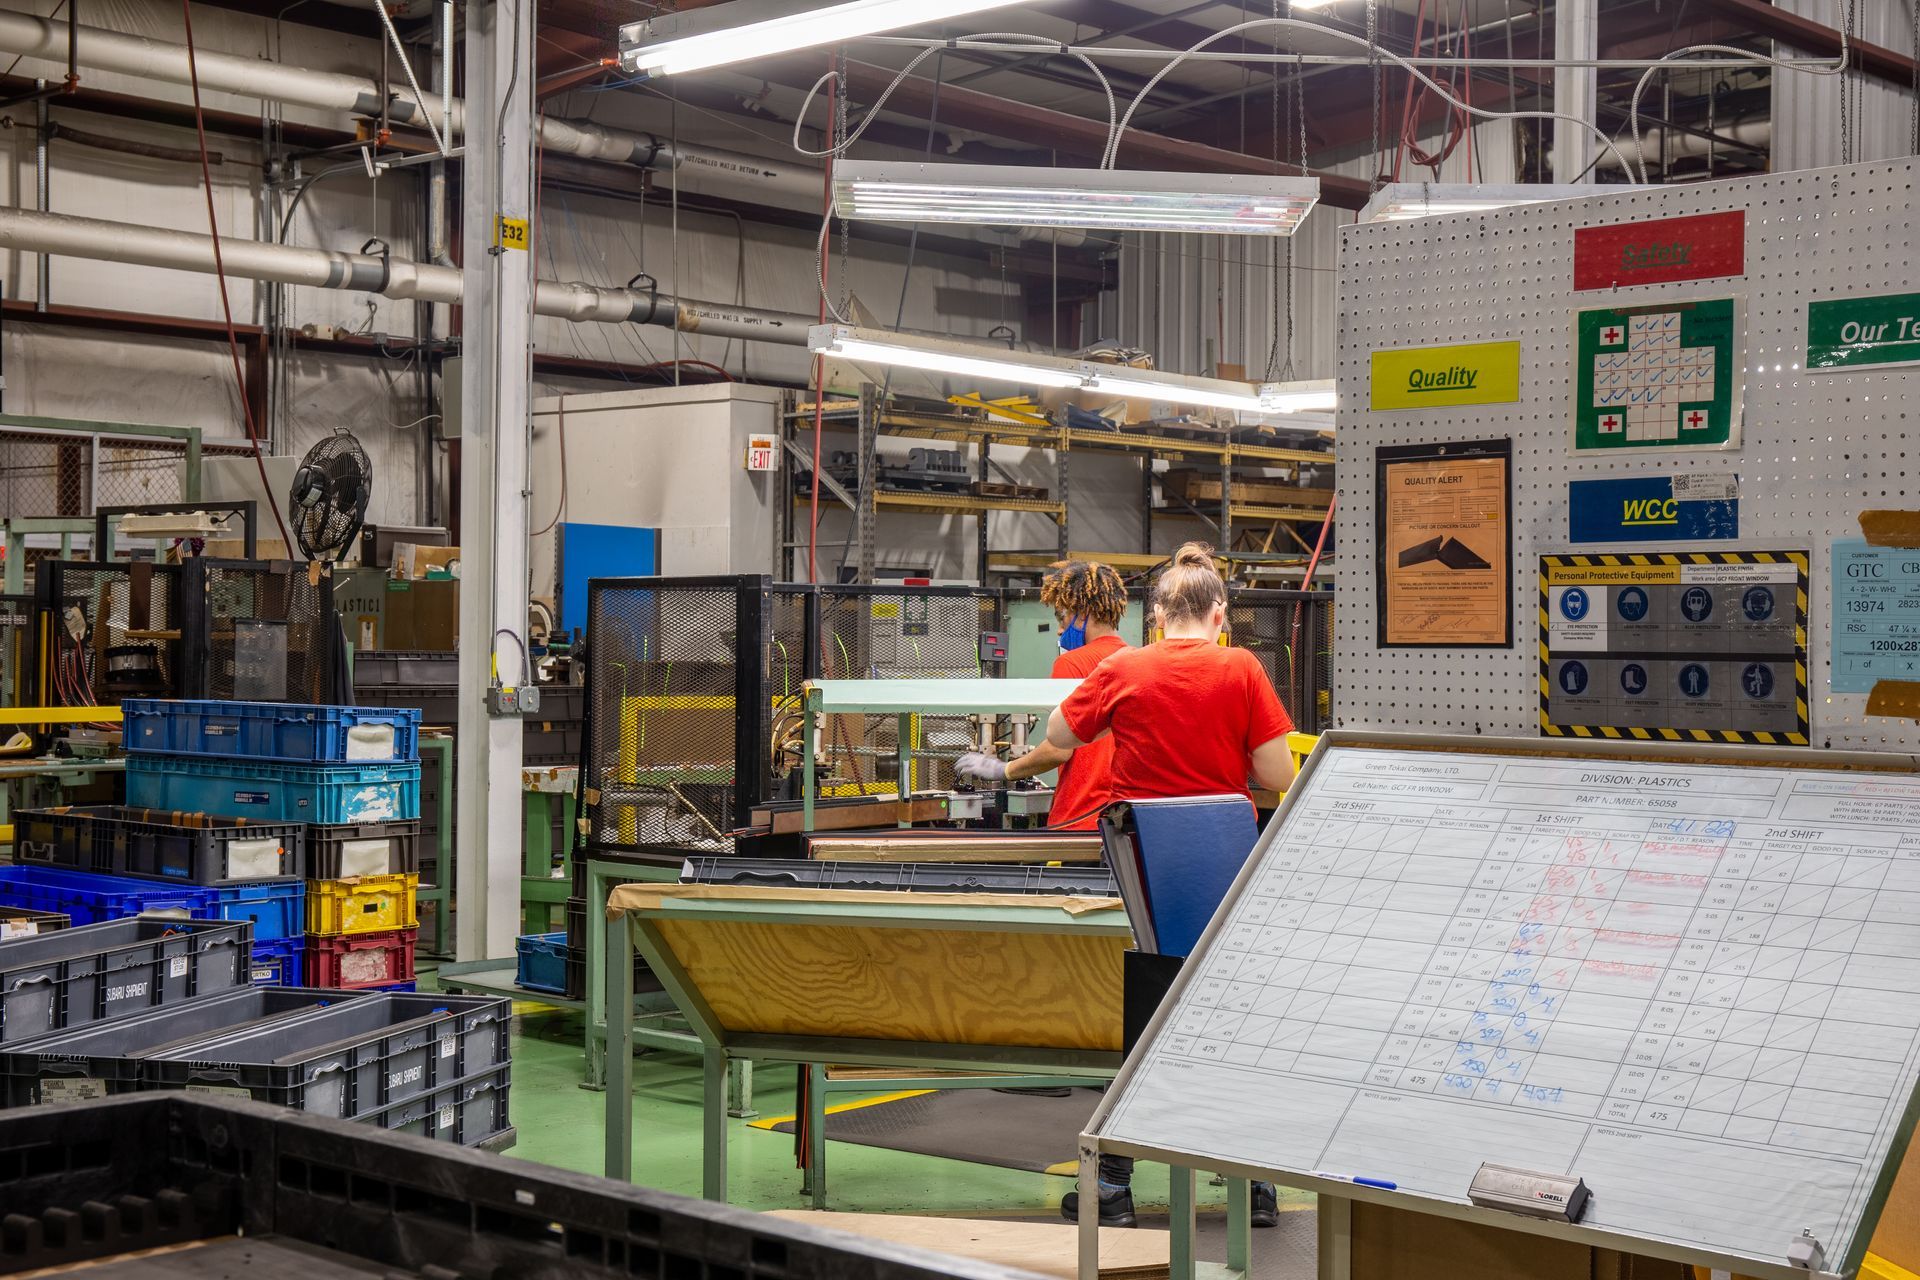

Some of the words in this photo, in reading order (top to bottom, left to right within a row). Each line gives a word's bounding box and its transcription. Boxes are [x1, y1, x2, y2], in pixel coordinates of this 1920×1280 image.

[739, 165, 759, 175] RETURN
[502, 223, 523, 241] E32
[1622, 242, 1692, 265] Safety
[743, 317, 762, 325] SUPPLY
[1841, 321, 1888, 343] Our
[1409, 366, 1478, 388] Quality
[754, 450, 771, 469] EXIT
[1404, 476, 1437, 486] QUALITY
[1438, 475, 1463, 484] ALERT
[1623, 499, 1679, 520] WCC
[1687, 565, 1716, 573] Department
[1847, 563, 1884, 578] GTC
[1554, 571, 1588, 580] Personal
[1589, 571, 1629, 580] Protective
[1631, 570, 1675, 580] Equipment
[1846, 601, 1885, 613] 13974
[1898, 600, 1920, 609] 2823
[1847, 624, 1867, 633] RSC
[1889, 625, 1899, 633] 47
[1864, 660, 1872, 668] of
[1365, 763, 1386, 771] Green
[1408, 765, 1442, 775] Company,
[1444, 767, 1460, 775] LTD.
[1580, 773, 1636, 785] DIVISION:
[1638, 776, 1692, 788] PLASTICS
[1352, 781, 1366, 789] Cell
[1418, 785, 1454, 794] WINDOW
[1332, 801, 1349, 809] 3rd
[1350, 802, 1376, 811] SHIFT
[1576, 795, 1600, 803] PART
[1602, 796, 1646, 806] NUMBER:
[1648, 799, 1677, 808] 65058
[1436, 808, 1455, 816] DATE:
[1536, 813, 1552, 823] 1st
[1553, 815, 1583, 825] SHIFT
[1765, 828, 1787, 838] 2nd
[1789, 829, 1824, 840] SHIFT
[106, 985, 124, 1001] SUBARU
[126, 982, 148, 999] SHIPMENT
[1374, 1075, 1390, 1083] TOTAL
[1410, 1076, 1427, 1085] 475
[1613, 1102, 1630, 1110] SHIFT
[1650, 1112, 1668, 1121] 475
[1540, 1192, 1562, 1202] LORELL
